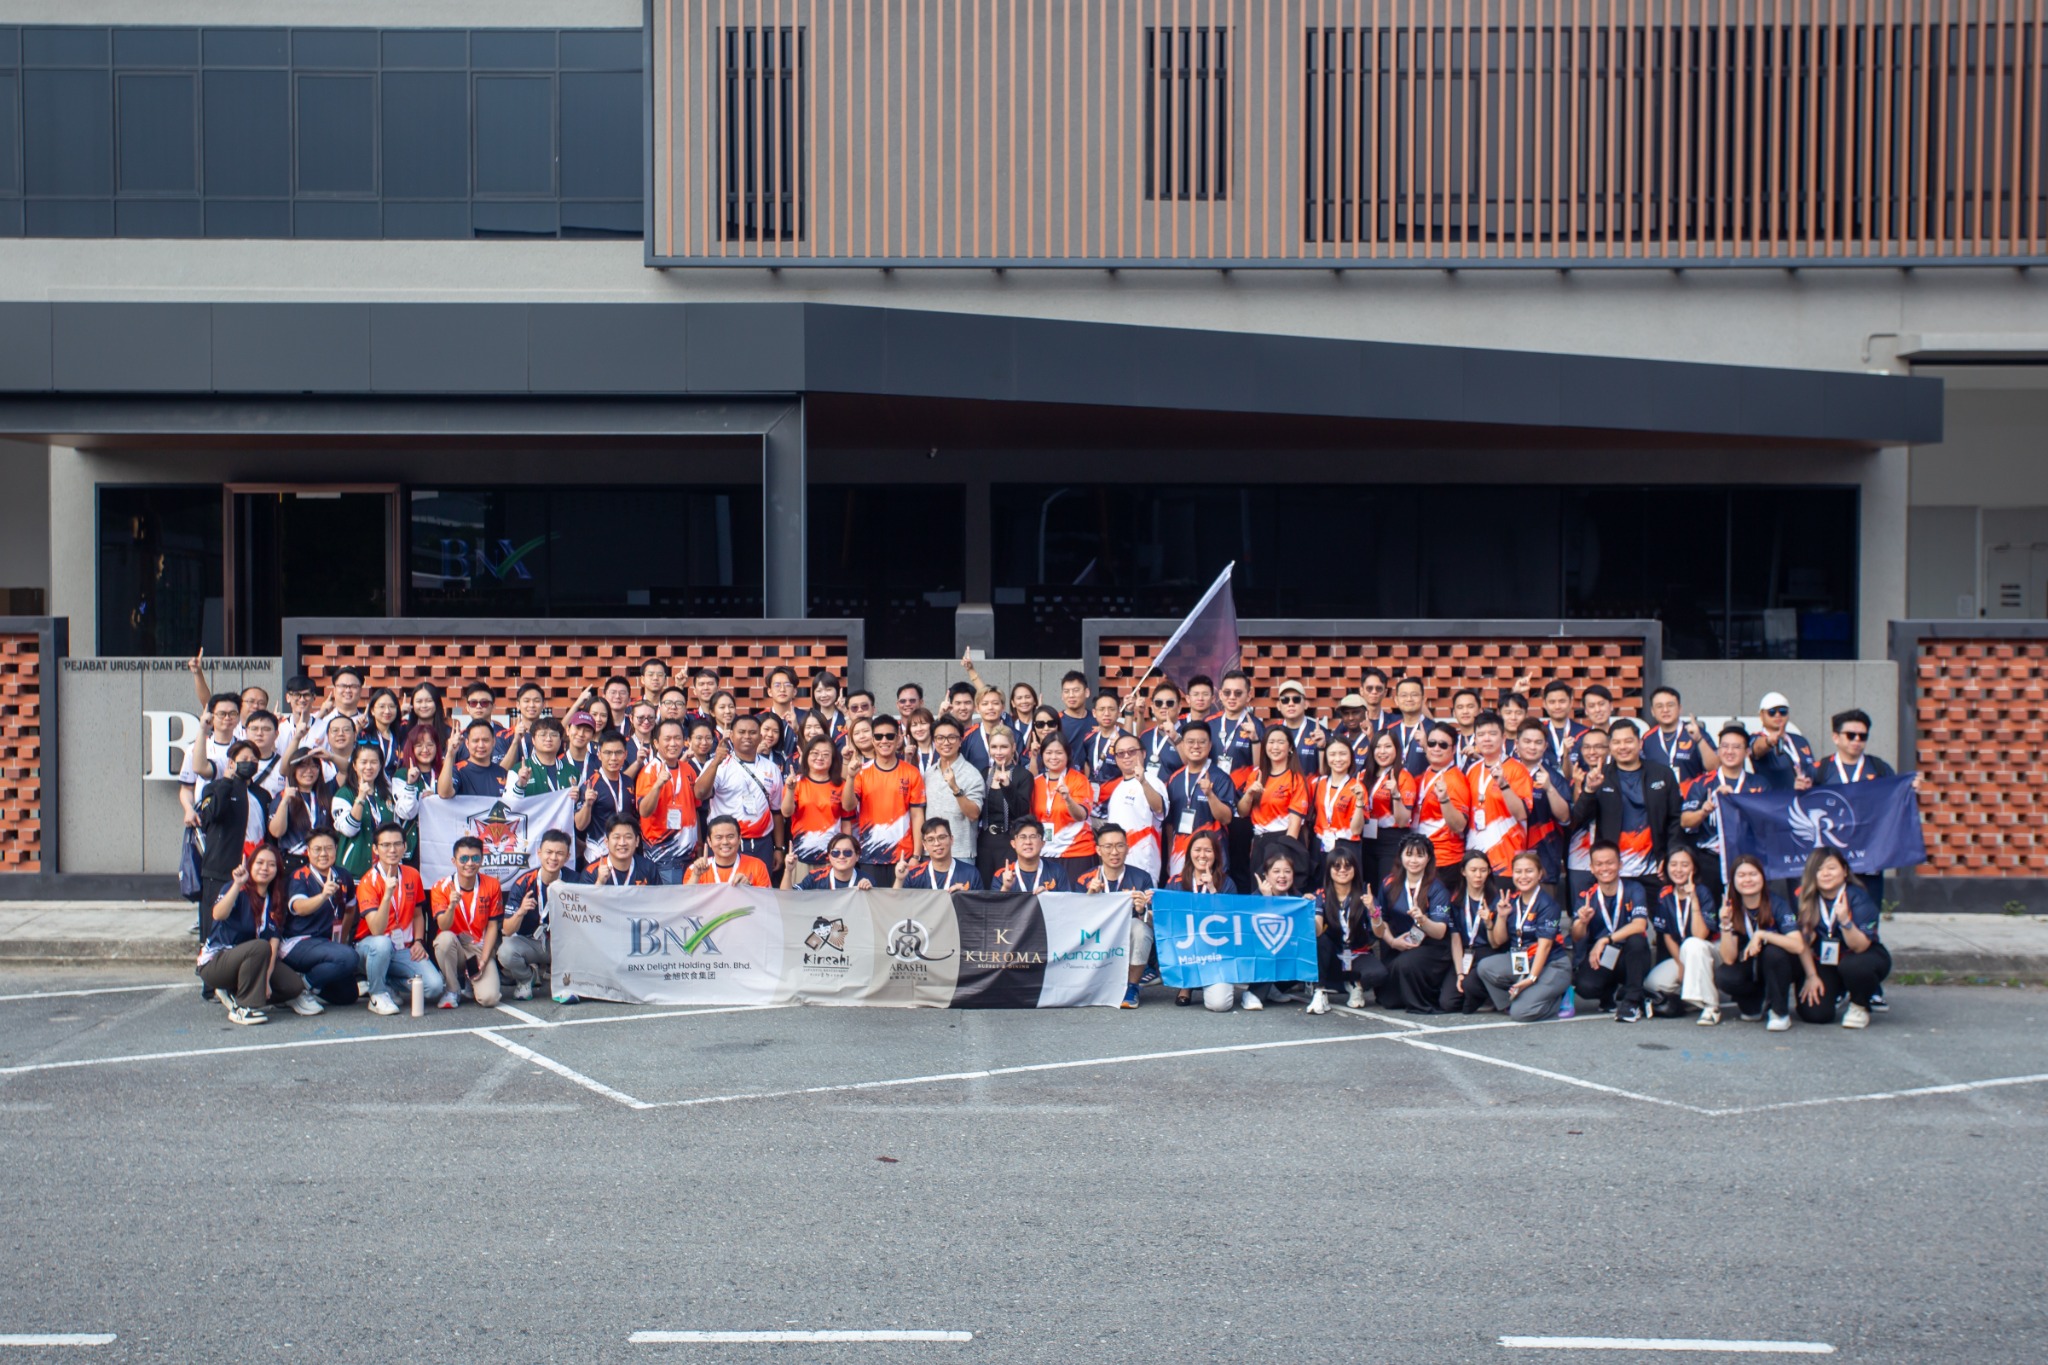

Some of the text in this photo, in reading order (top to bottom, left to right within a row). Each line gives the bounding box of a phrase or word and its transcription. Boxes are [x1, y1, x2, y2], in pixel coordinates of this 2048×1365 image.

[64, 660, 271, 671] PEJABAT URUSAN DAN PEUAT MAKANAN
[559, 892, 580, 902] ONE
[561, 902, 587, 912] TEAM
[562, 911, 602, 923] ALWAYS
[628, 916, 722, 957] BNX
[1176, 914, 1242, 949] JCI
[965, 951, 1043, 963] KUROMA
[1178, 953, 1222, 966] Malaysia
[628, 960, 752, 972] BNX Delight Holding Sdn. Bhd.
[889, 963, 927, 972] ARASHI
